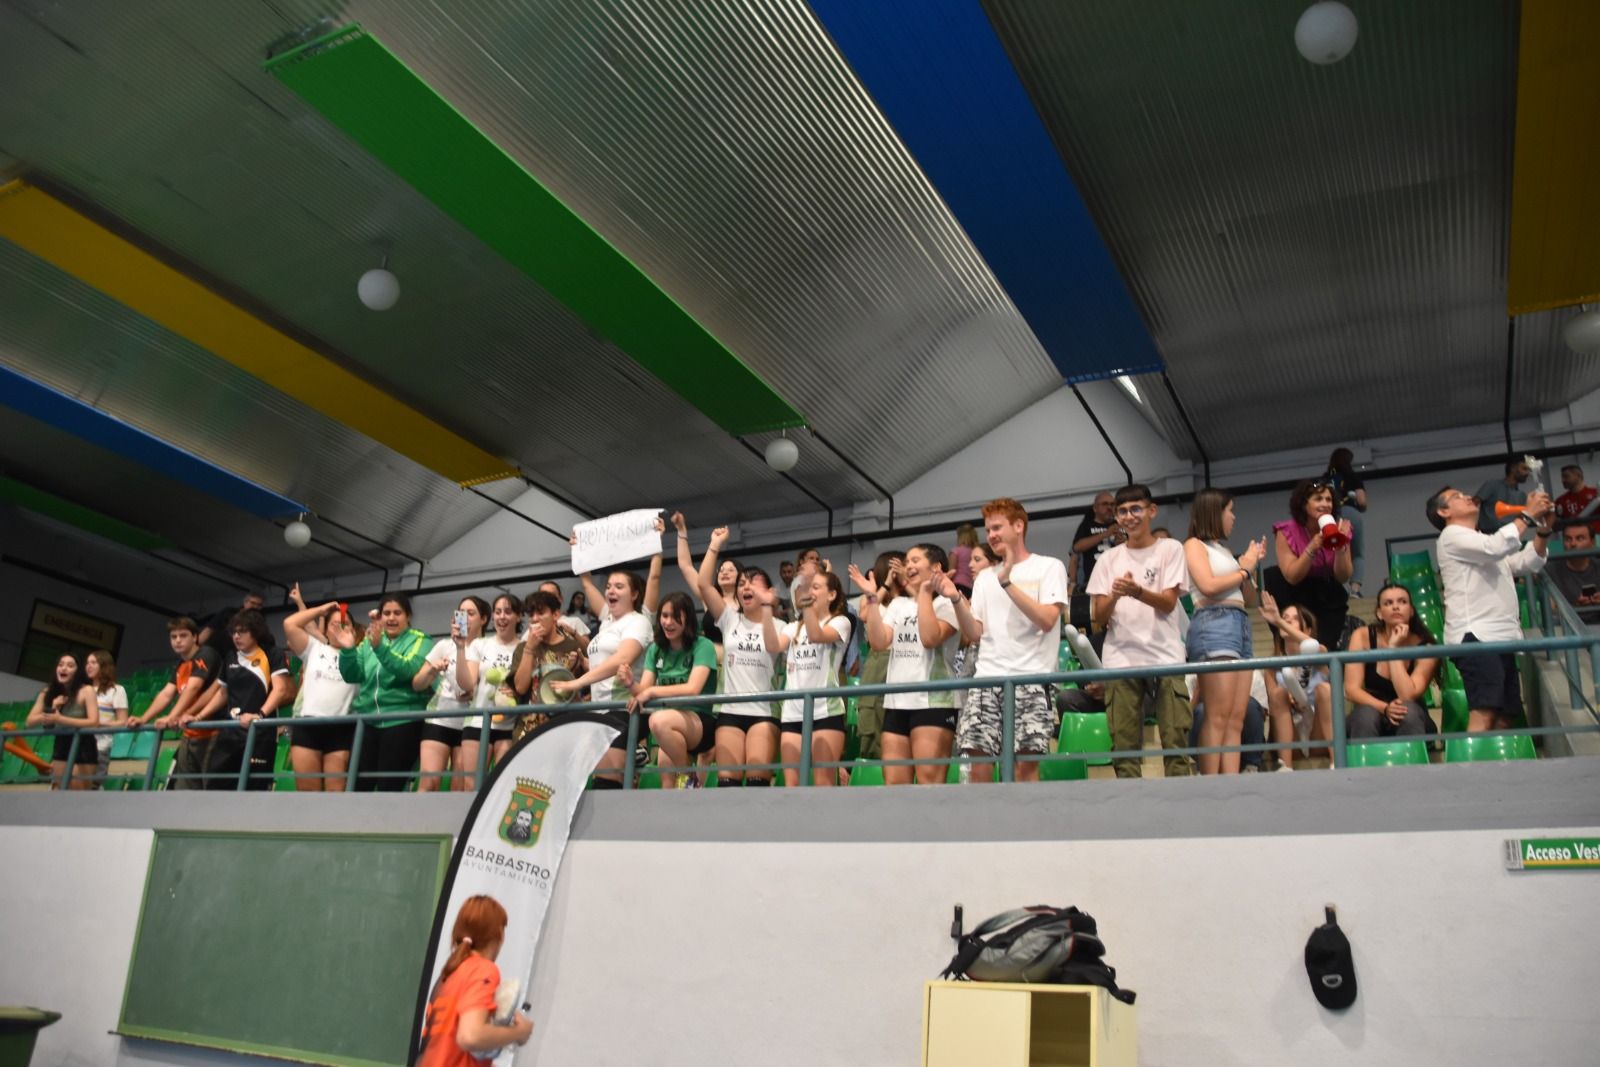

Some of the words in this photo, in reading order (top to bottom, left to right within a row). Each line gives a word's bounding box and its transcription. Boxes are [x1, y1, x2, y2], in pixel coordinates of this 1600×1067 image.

[897, 632, 918, 643] S.M.A
[737, 642, 762, 653] S.M.A
[795, 648, 818, 660] S.M.A
[1526, 843, 1571, 860] Acceso
[466, 846, 551, 879] BARBASTRO
[463, 861, 547, 889] AYUNTAMIENTO
